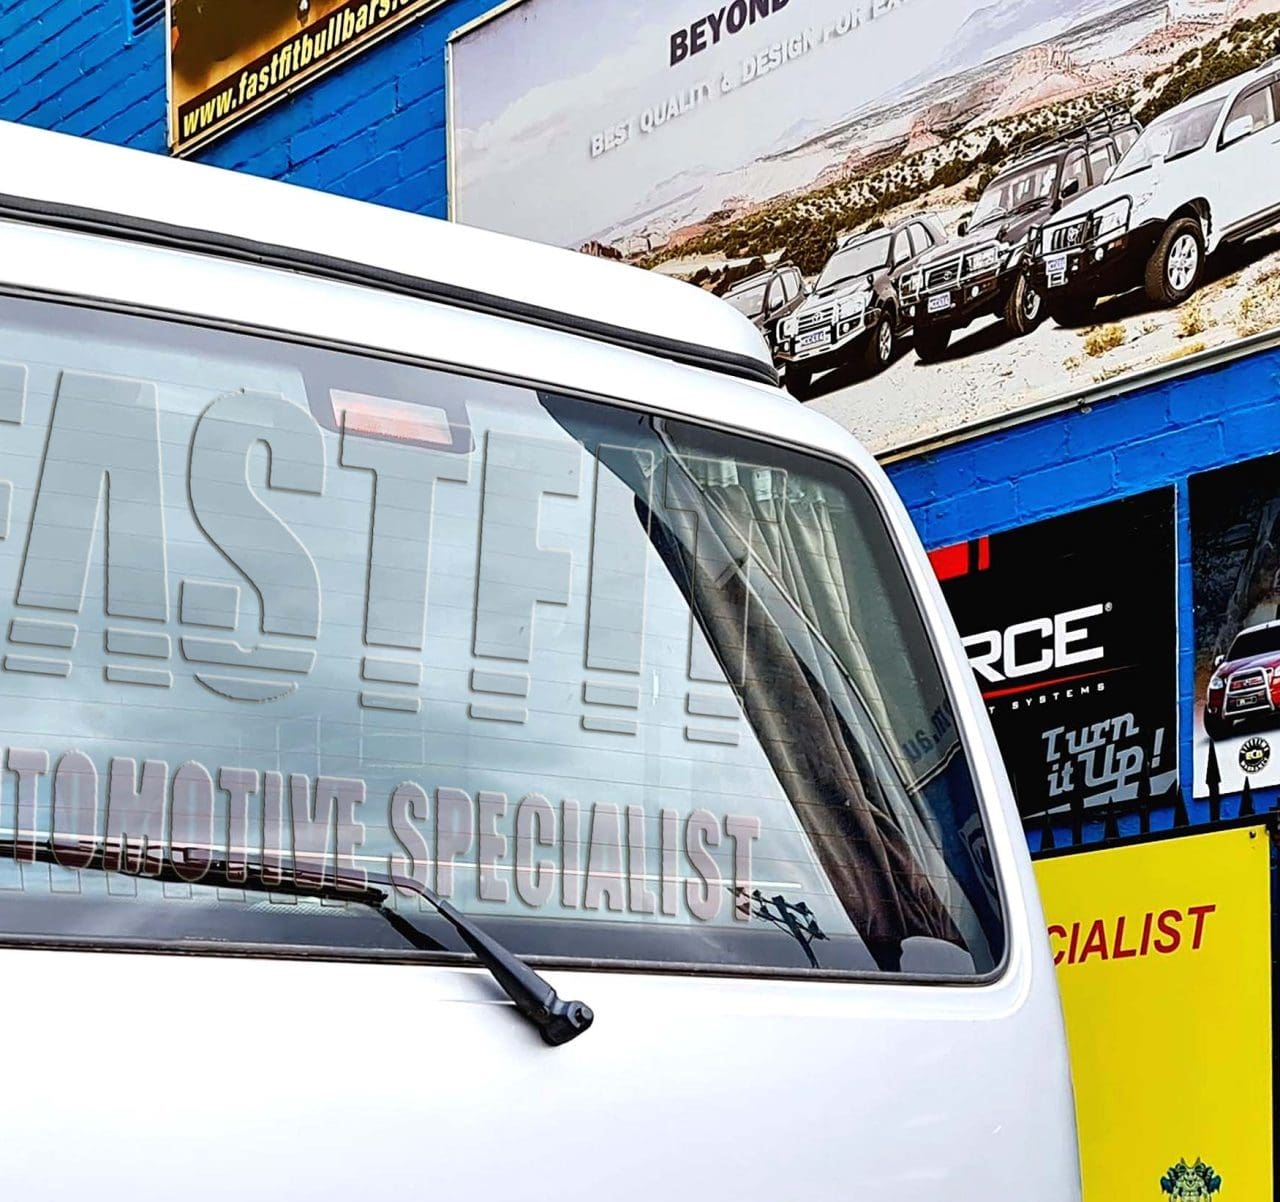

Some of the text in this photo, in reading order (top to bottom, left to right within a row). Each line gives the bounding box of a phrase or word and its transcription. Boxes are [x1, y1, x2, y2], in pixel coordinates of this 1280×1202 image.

[590, 119, 634, 158] BEST
[742, 28, 818, 84] DESIGN
[1012, 683, 1105, 709] SYSTEMS
[1041, 712, 1140, 762] Turn
[1047, 760, 1075, 797] it
